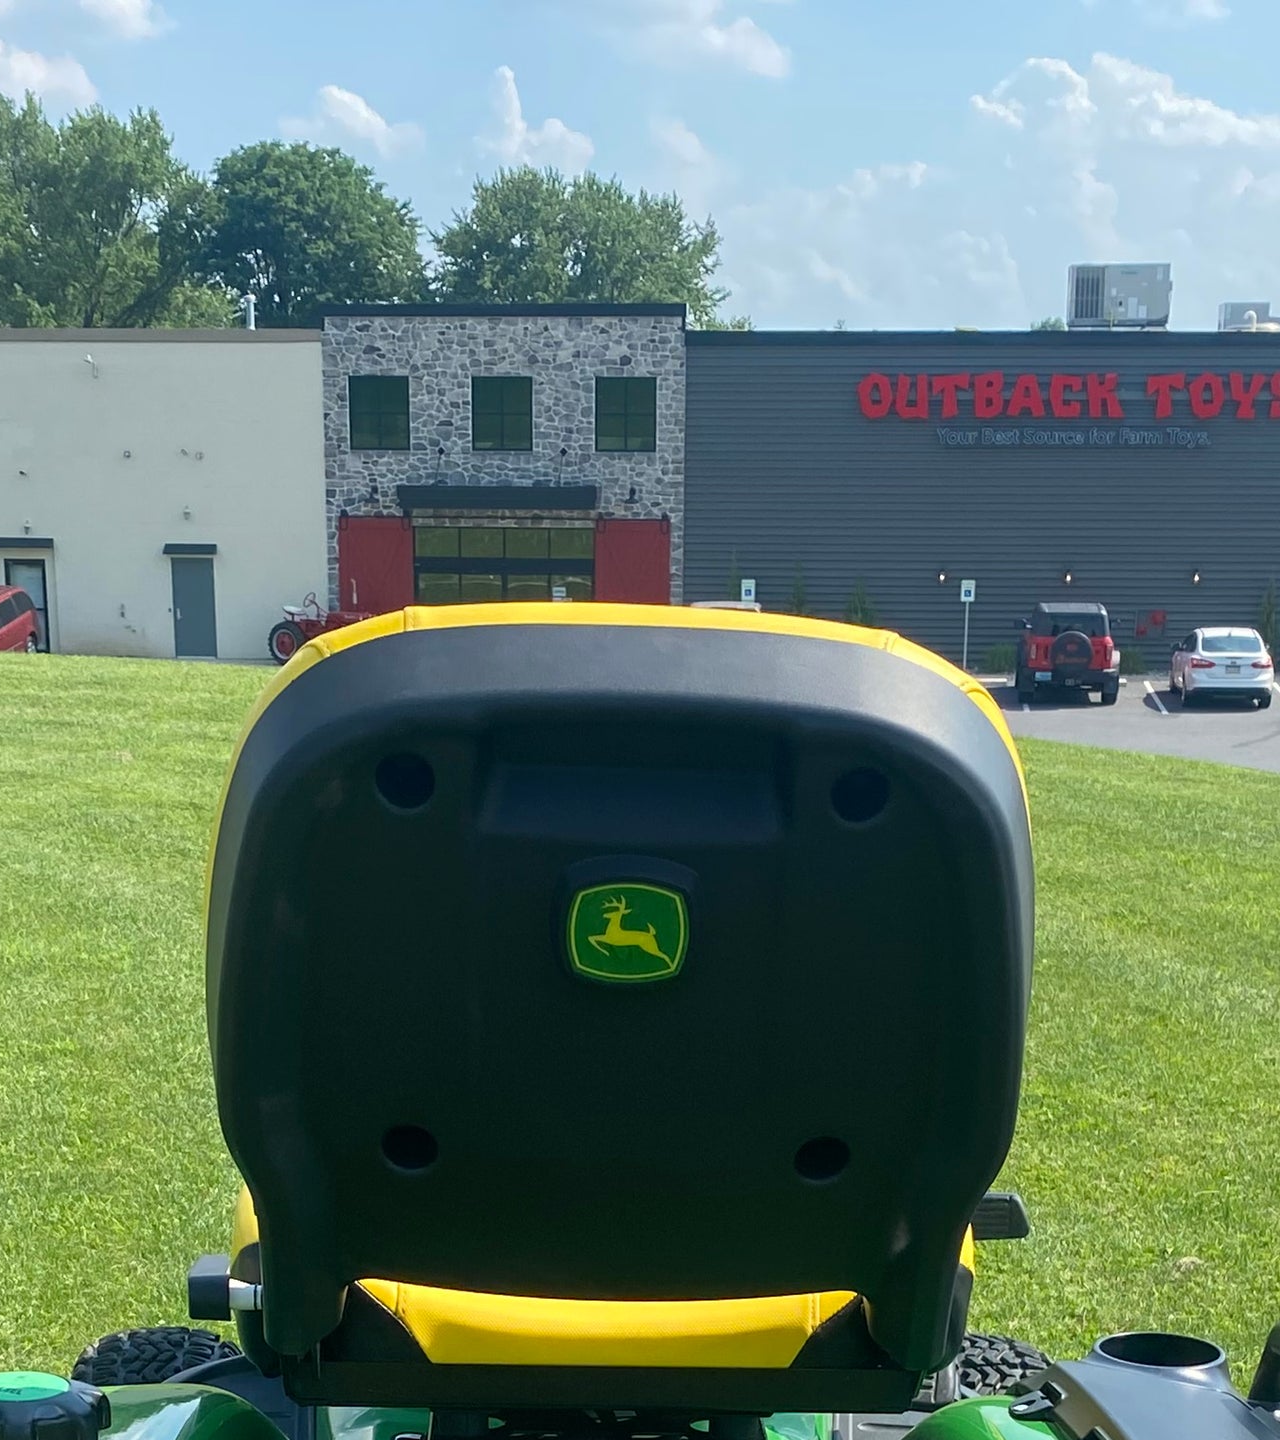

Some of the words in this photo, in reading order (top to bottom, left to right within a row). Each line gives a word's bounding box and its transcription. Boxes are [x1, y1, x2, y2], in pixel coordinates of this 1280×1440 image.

[856, 371, 1125, 419] OUTBACK
[937, 427, 978, 445] Your
[981, 427, 1019, 445] Best
[1023, 427, 1084, 445] Source
[1089, 427, 1115, 445] for
[1120, 427, 1163, 445] Farm
